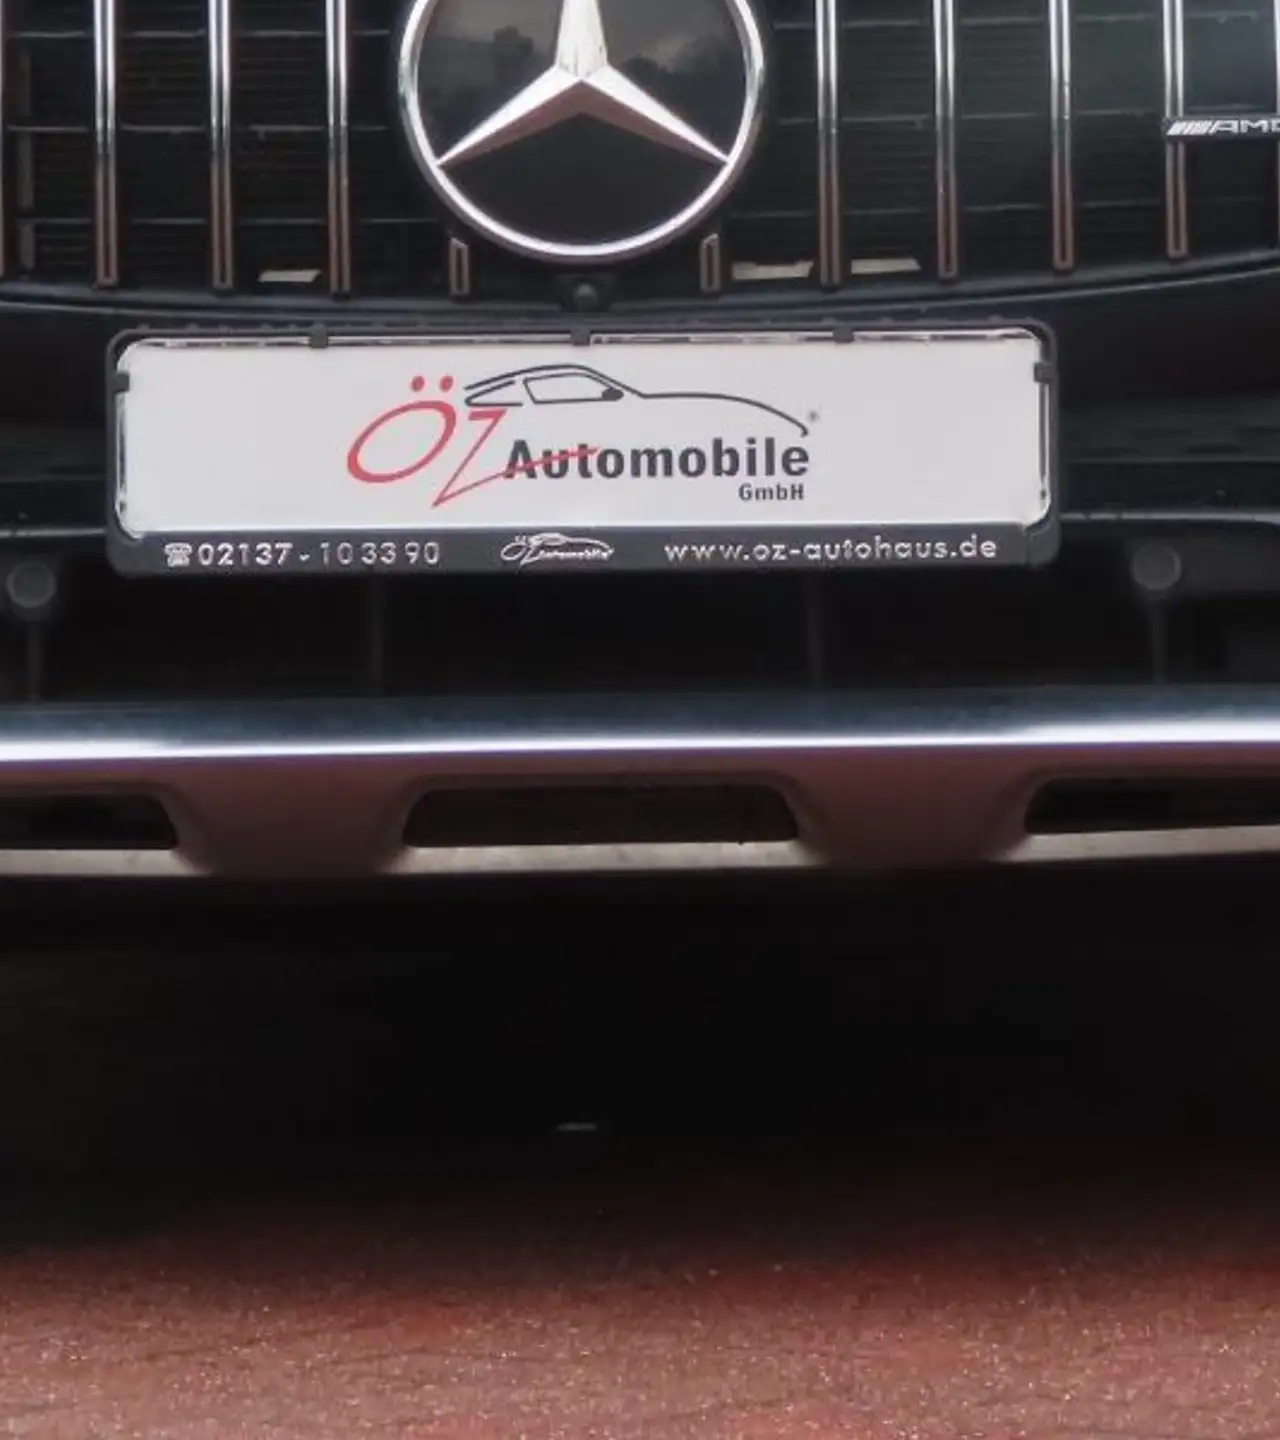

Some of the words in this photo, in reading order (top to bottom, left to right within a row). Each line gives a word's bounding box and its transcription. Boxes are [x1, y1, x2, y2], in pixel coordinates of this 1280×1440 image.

[505, 436, 810, 480] Automobile
[738, 482, 806, 502] GmbH
[663, 533, 998, 562] www.oz-autohaus.de
